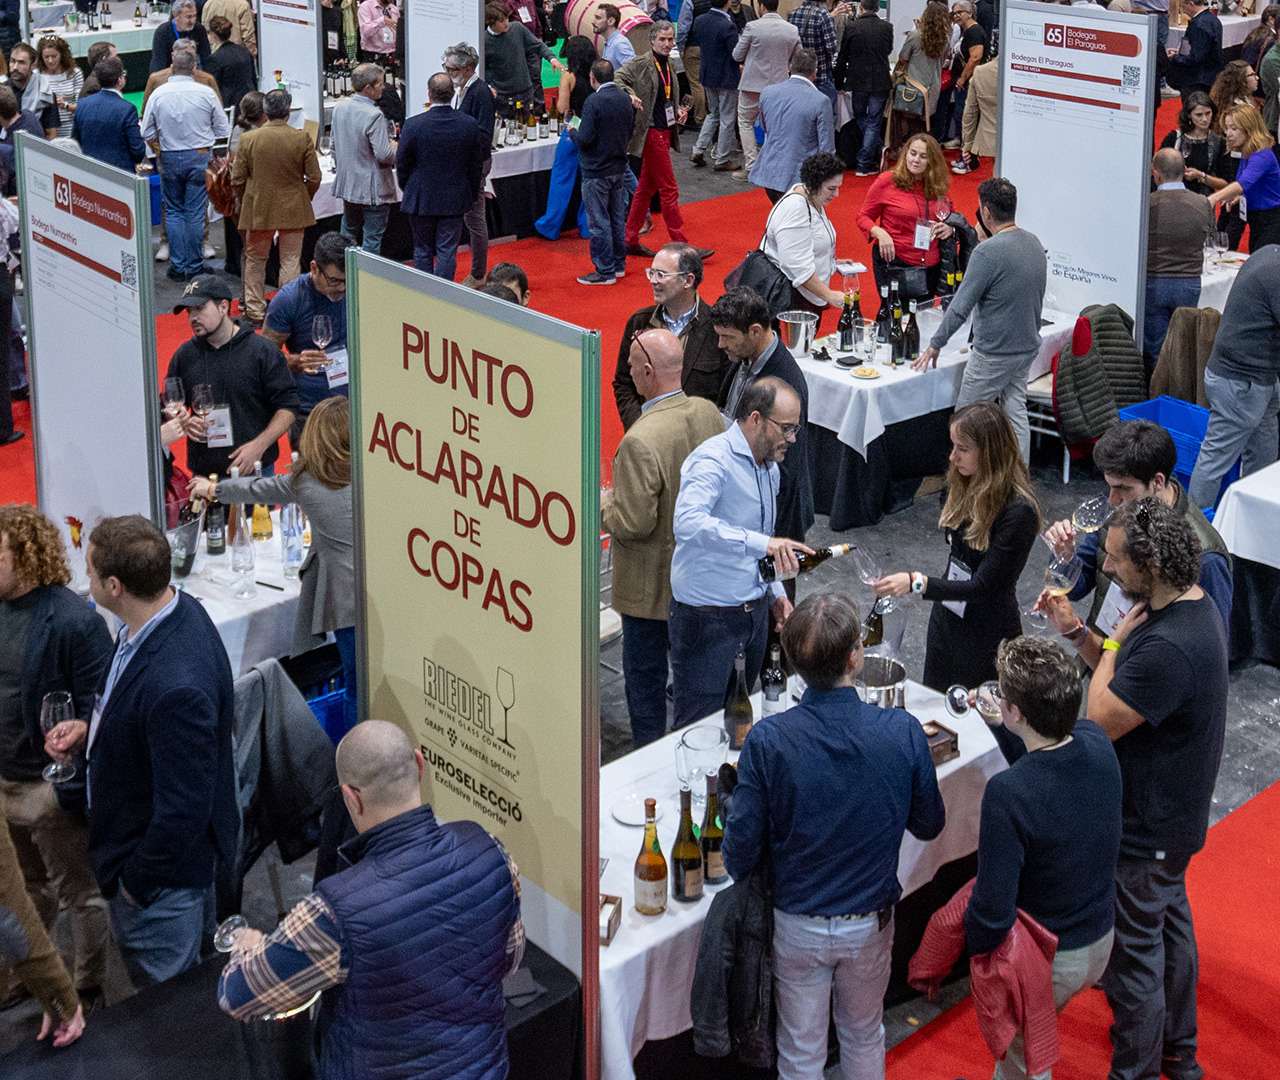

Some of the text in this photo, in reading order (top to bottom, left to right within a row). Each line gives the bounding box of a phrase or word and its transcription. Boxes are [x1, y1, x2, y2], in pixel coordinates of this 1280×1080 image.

[1018, 27, 1036, 37] Peñín
[1046, 28, 1097, 43] 65 Bodegas
[1067, 38, 1106, 51] El Paraguas
[1011, 53, 1037, 64] Bodegas
[1045, 57, 1074, 68] Paraguas
[56, 182, 127, 227] 63 Bodega Numanthia
[31, 215, 77, 245] Bodega Numanthia
[1064, 270, 1091, 284] España
[1078, 267, 1100, 279] Mejores
[1101, 273, 1117, 283] Vinos
[402, 322, 534, 418] PUNTO
[452, 406, 480, 444] DE
[368, 412, 575, 546] ACLARADO
[454, 509, 481, 547] DE
[407, 528, 533, 632] COPAS
[423, 657, 495, 736] RIEDEL
[424, 698, 516, 761] THE WINE GLASS COMPANY
[424, 717, 444, 736] GRAPE
[459, 740, 489, 765] VARIETAL
[421, 744, 522, 822] EUROSELECCIÓ
[435, 771, 507, 827] Exclusive importer
